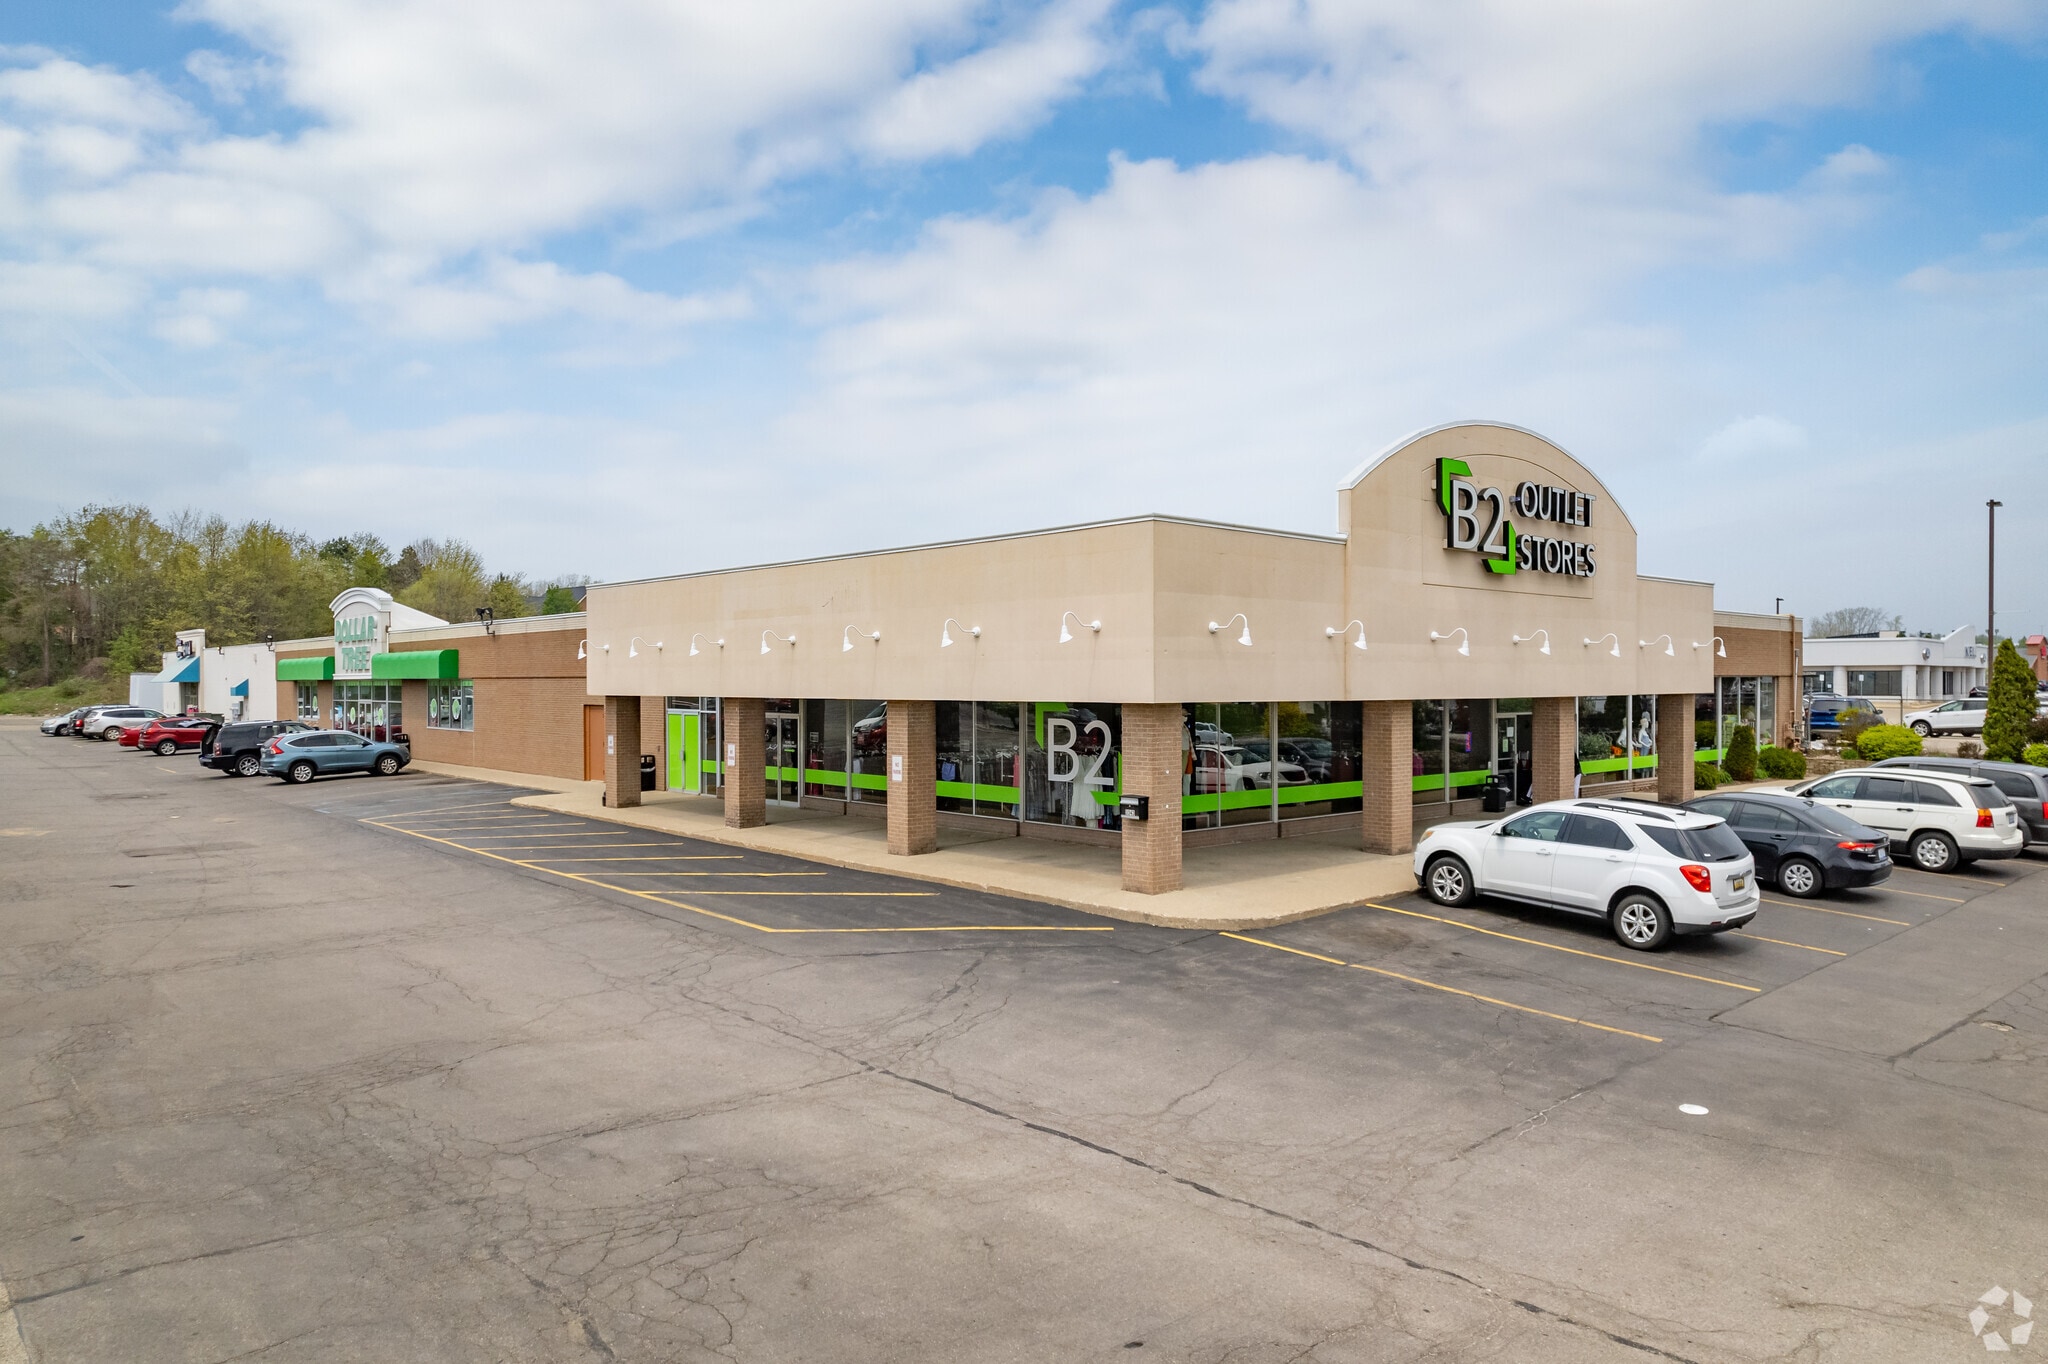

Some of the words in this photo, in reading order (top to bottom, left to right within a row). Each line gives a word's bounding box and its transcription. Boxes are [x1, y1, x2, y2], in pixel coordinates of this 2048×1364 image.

[1449, 479, 1507, 555] B2
[1516, 481, 1596, 527] OUTLET
[1515, 534, 1597, 577] STORES
[335, 616, 377, 642] DOLLAR
[341, 646, 370, 671] TREE
[1047, 718, 1114, 786] B2
